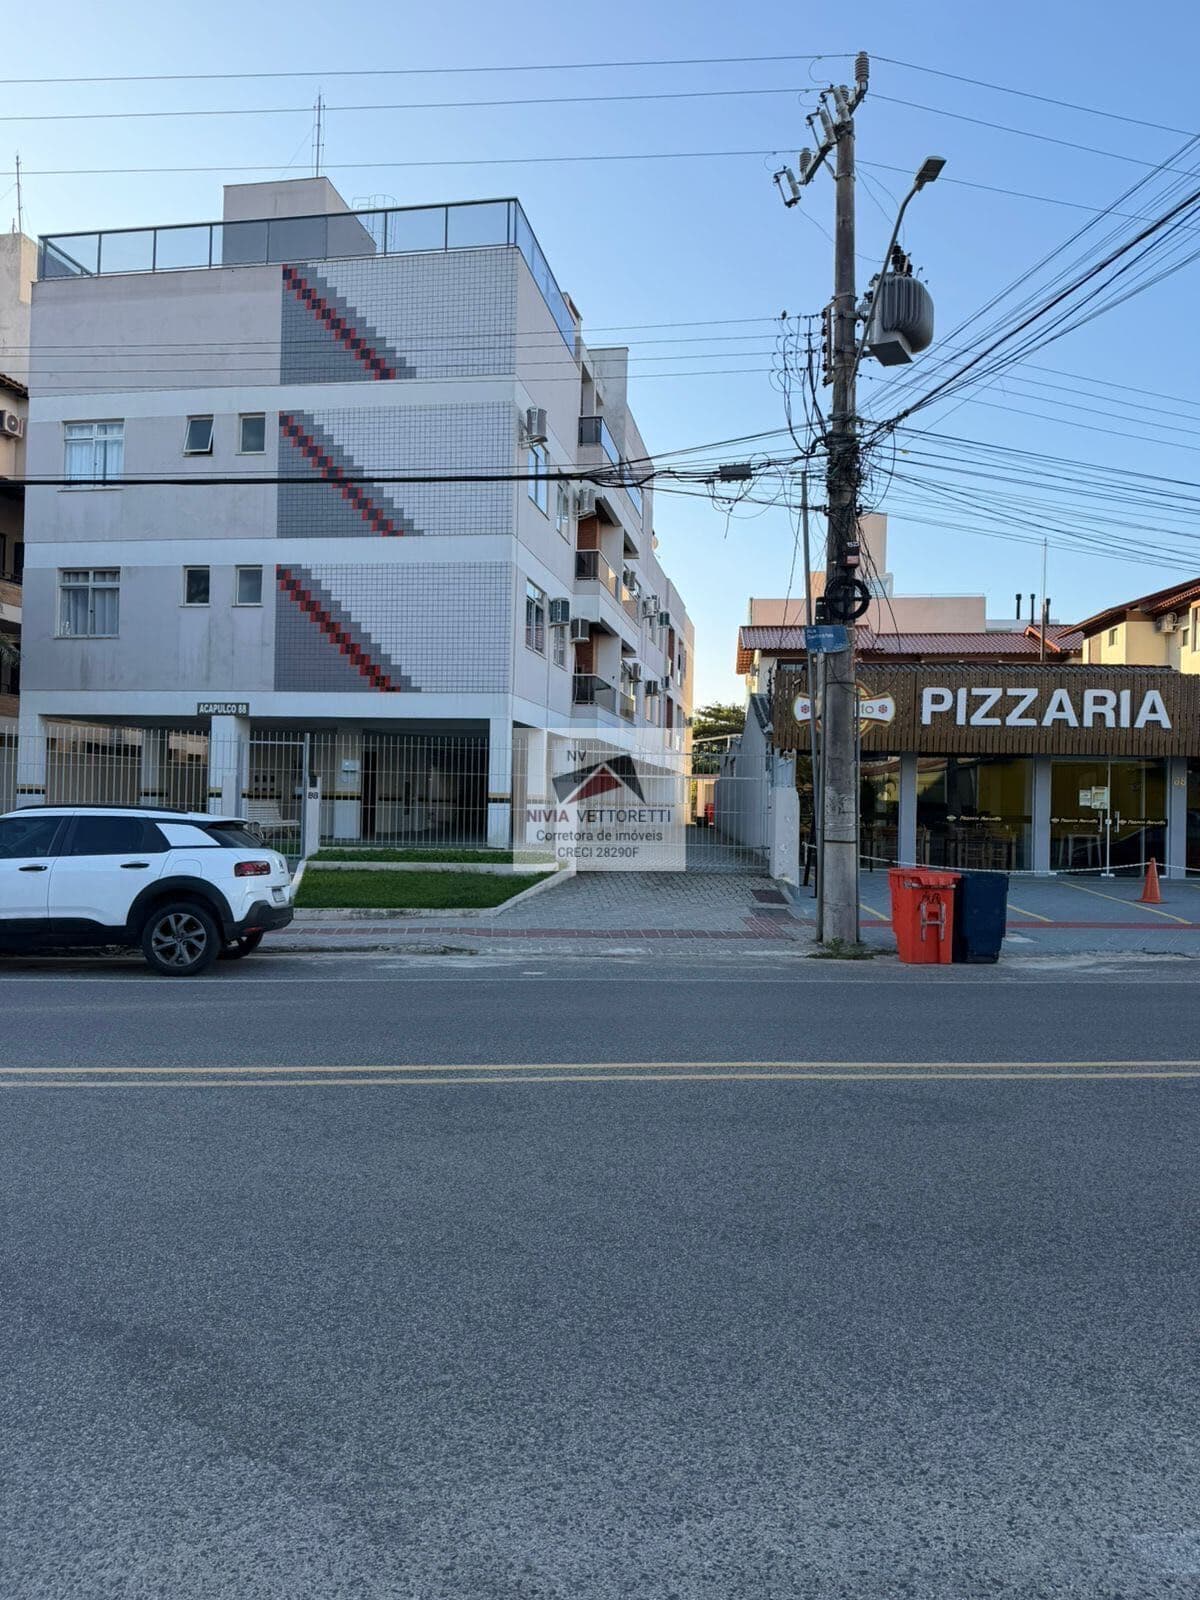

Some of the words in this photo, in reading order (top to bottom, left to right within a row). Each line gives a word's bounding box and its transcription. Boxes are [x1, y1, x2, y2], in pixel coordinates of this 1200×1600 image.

[199, 704, 237, 713] ACAPULCO
[238, 704, 247, 713] 88
[921, 687, 1172, 729] PIZZARIA
